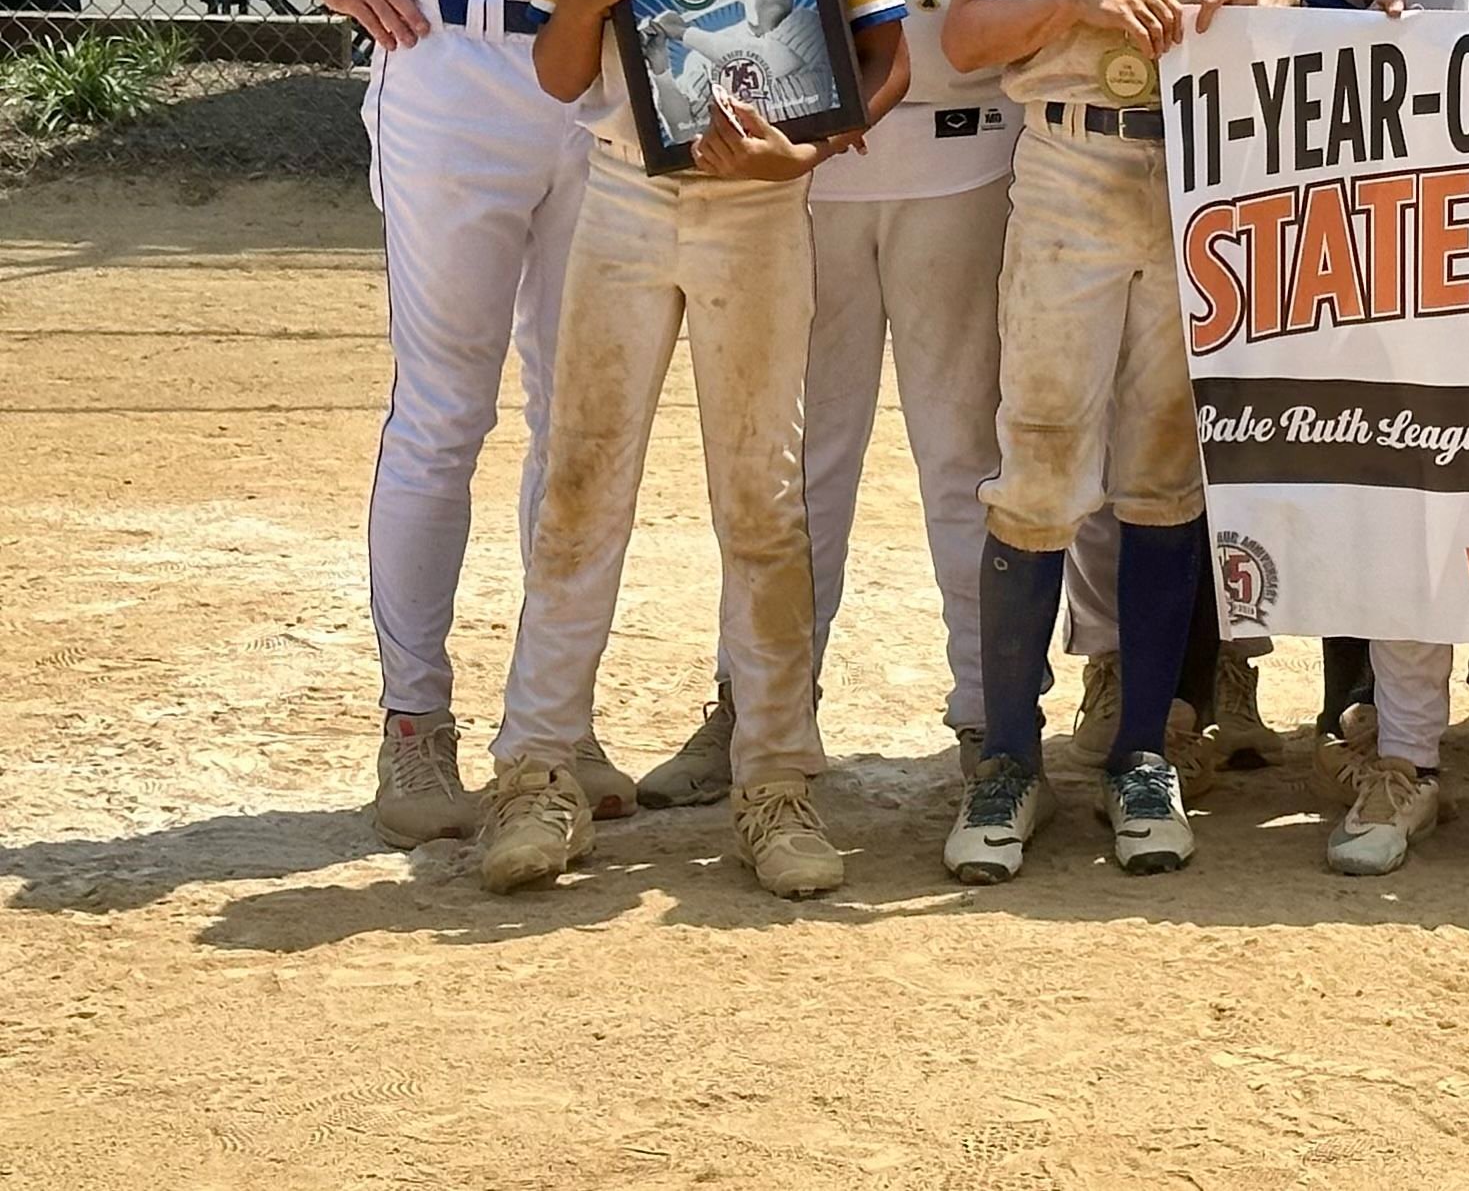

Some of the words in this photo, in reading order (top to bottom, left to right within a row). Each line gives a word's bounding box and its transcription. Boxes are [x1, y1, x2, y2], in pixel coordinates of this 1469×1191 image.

[1197, 404, 1276, 443] Babe
[1279, 405, 1373, 445] Ruth
[1223, 554, 1253, 604] 5
